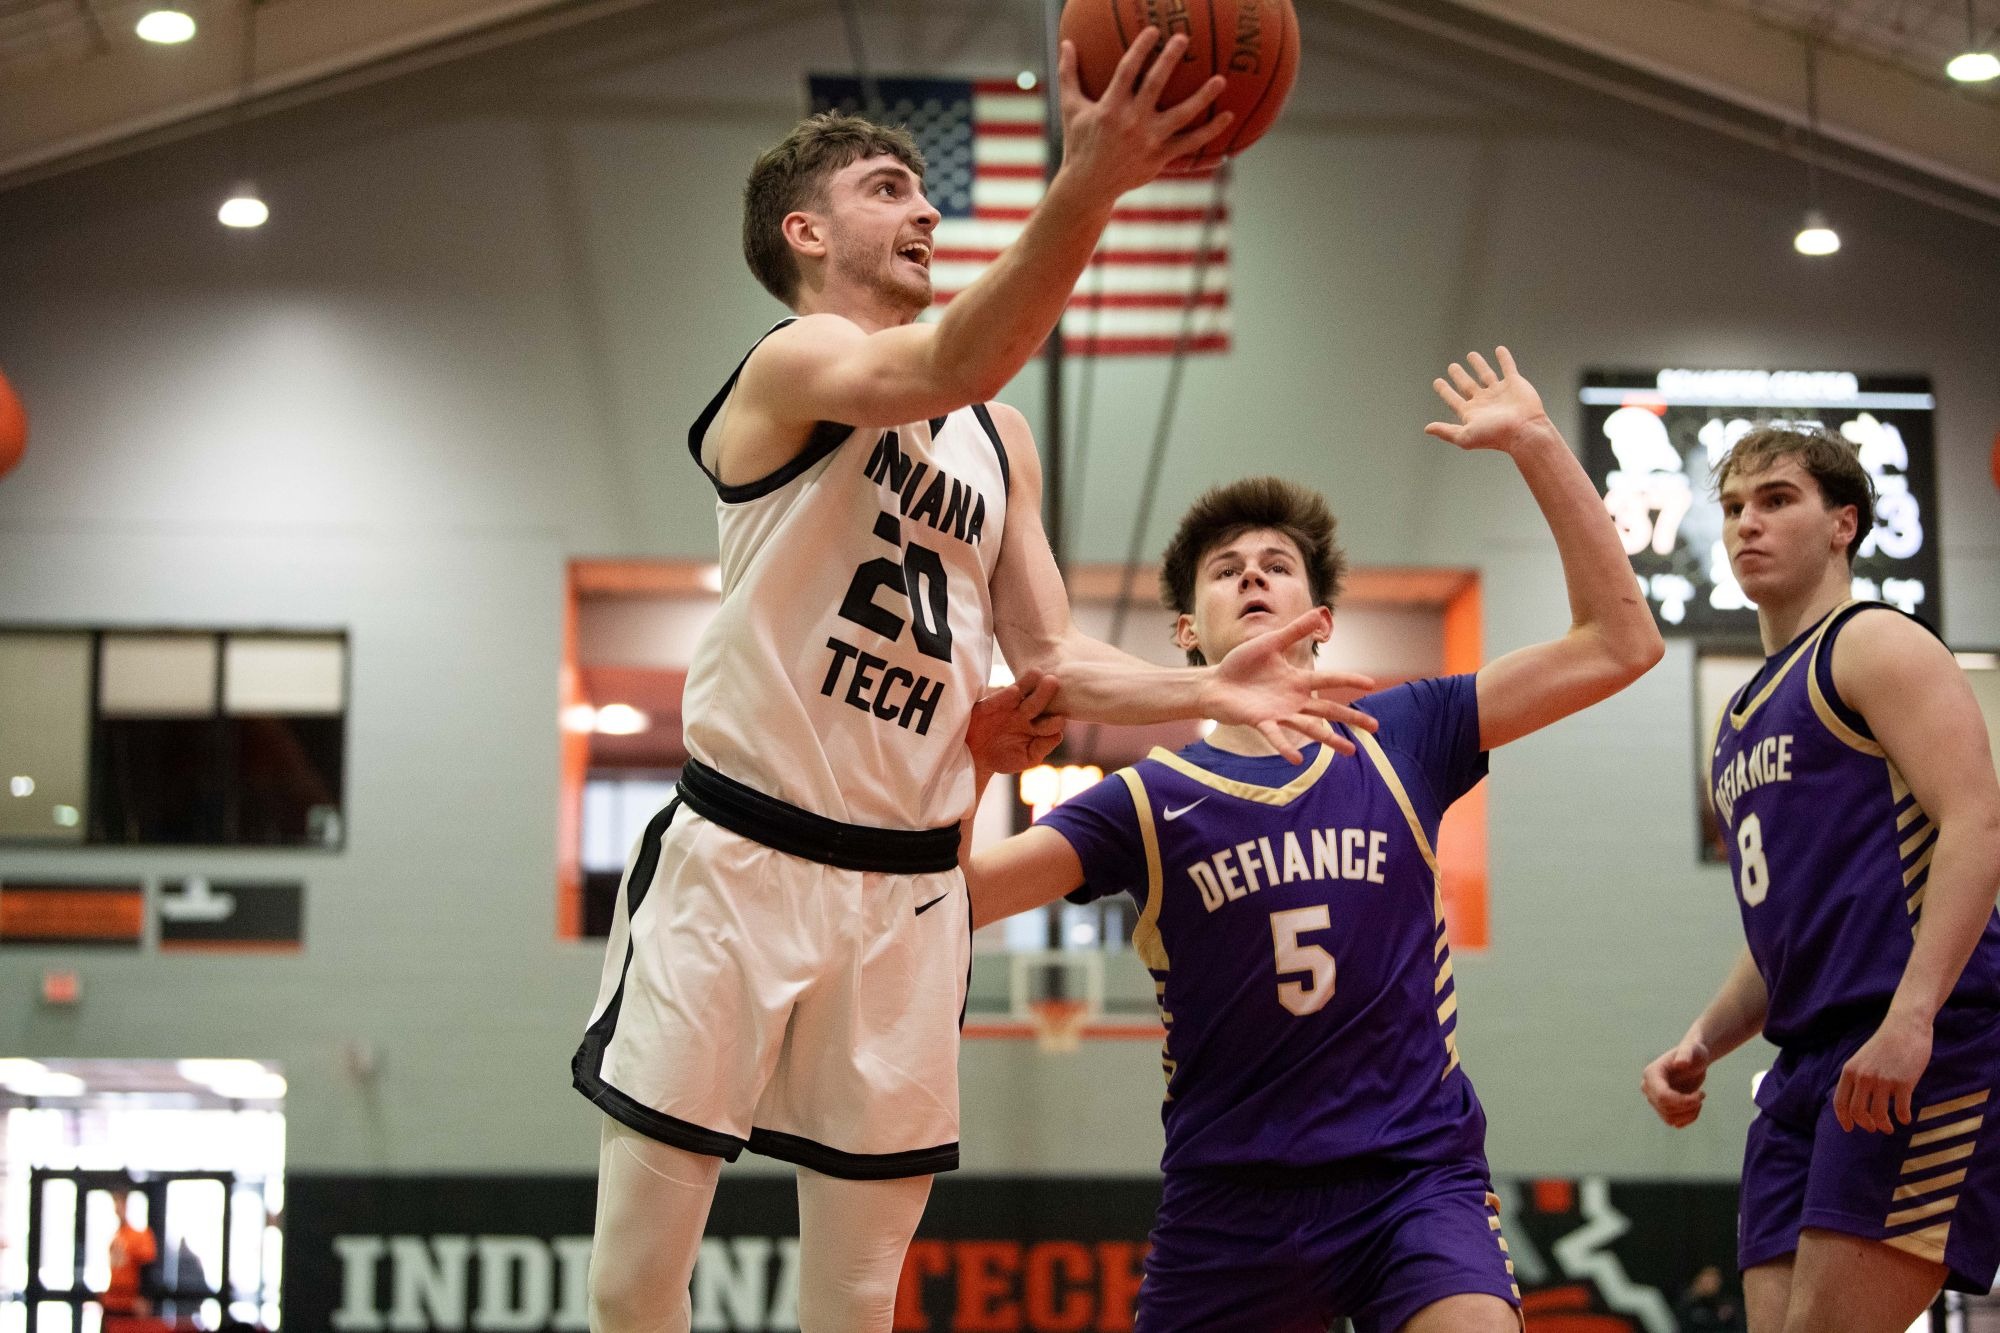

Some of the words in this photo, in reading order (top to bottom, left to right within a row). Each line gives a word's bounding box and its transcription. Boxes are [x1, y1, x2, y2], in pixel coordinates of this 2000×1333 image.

[838, 510, 953, 664] 20
[820, 636, 945, 737] TECH
[1186, 827, 1388, 913] DEFIANCE
[1737, 812, 1770, 908] 8
[1269, 904, 1337, 1017] 5
[331, 1234, 801, 1332] INDIN
